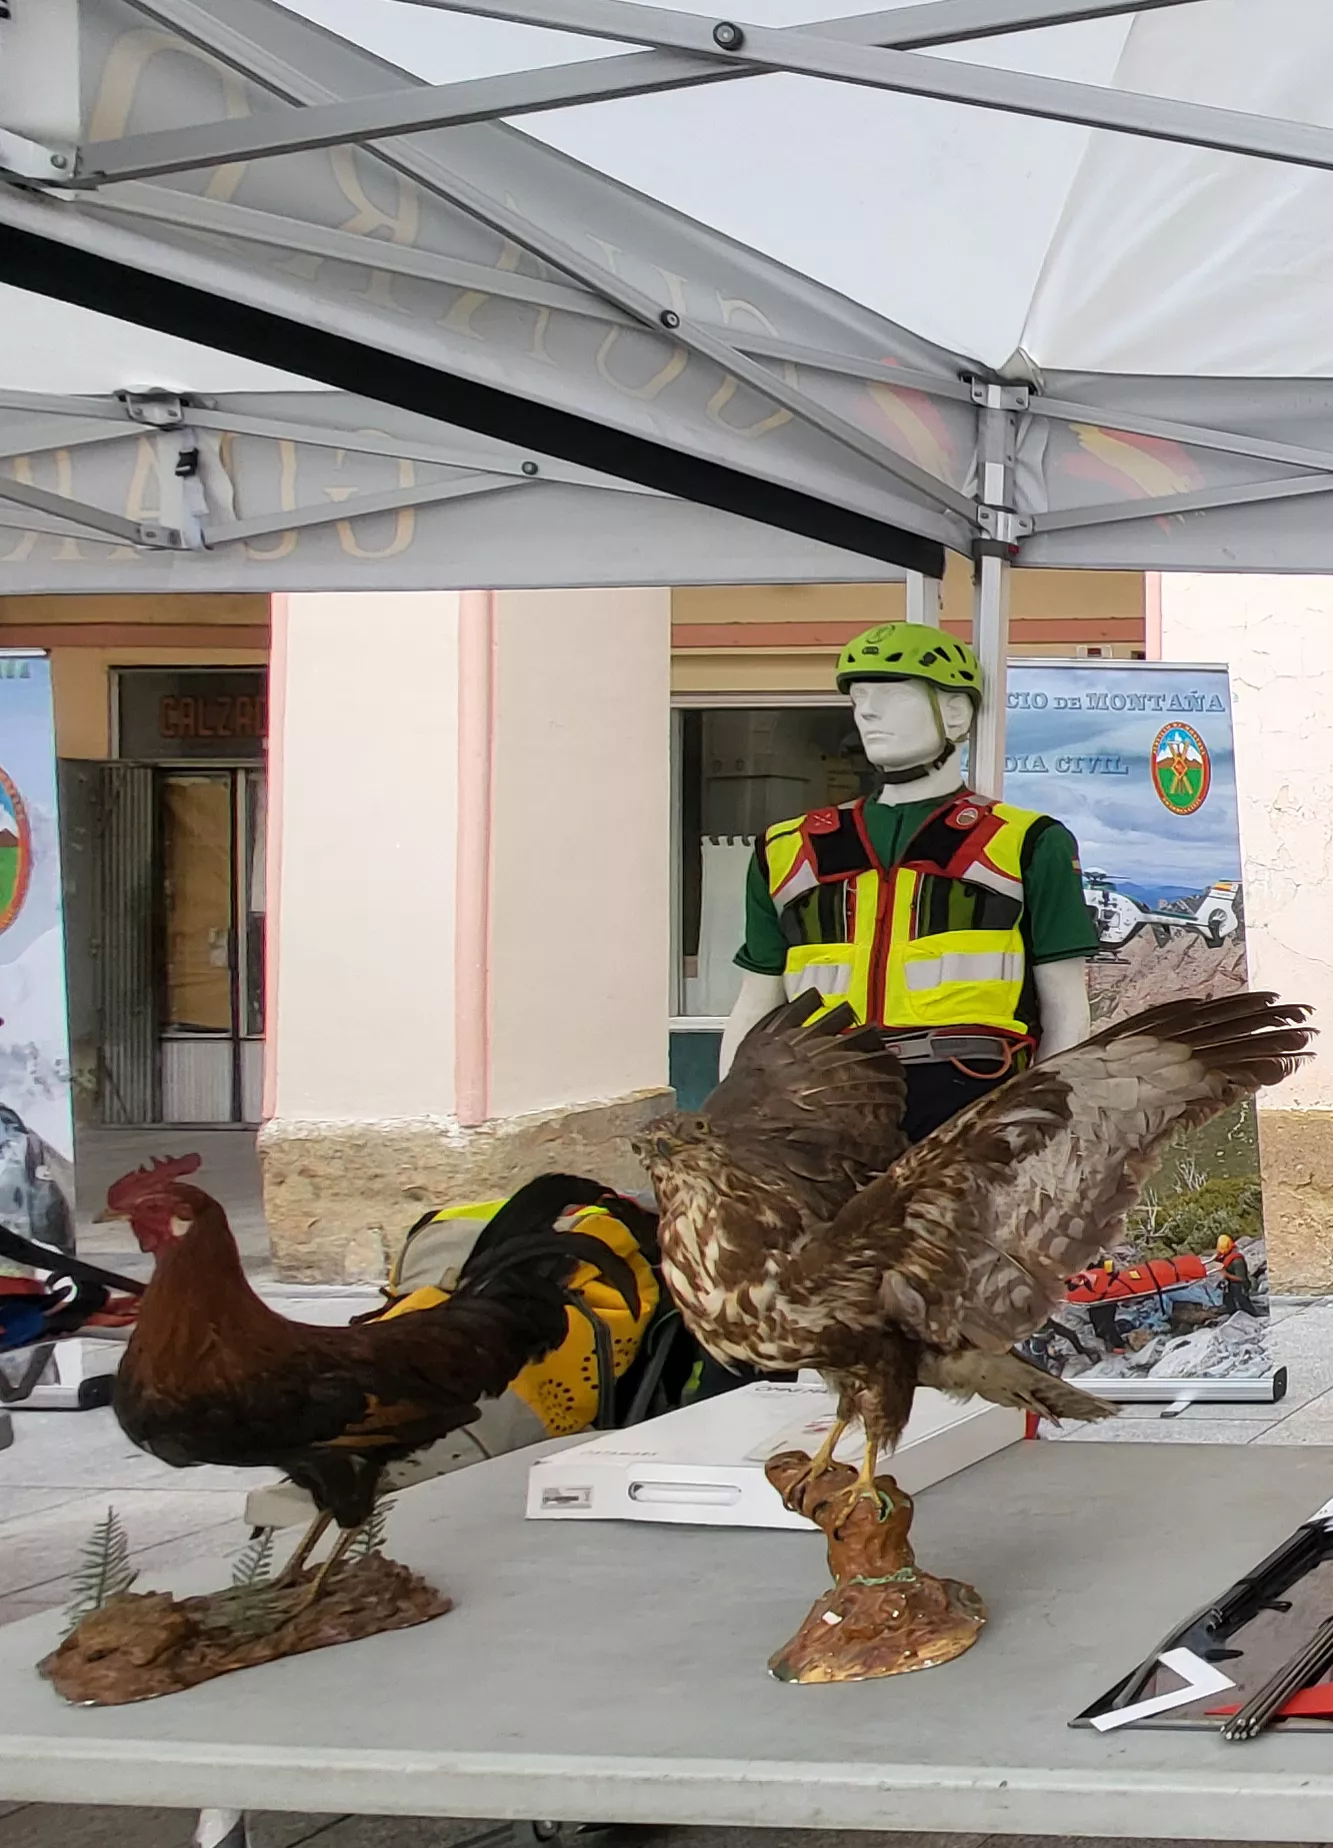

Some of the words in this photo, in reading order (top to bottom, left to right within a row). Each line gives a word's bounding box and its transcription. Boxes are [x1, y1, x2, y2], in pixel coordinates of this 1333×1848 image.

[1053, 696, 1082, 710] DE
[1085, 690, 1226, 713] MONTAÑA
[1055, 756, 1129, 775] CIVIL
